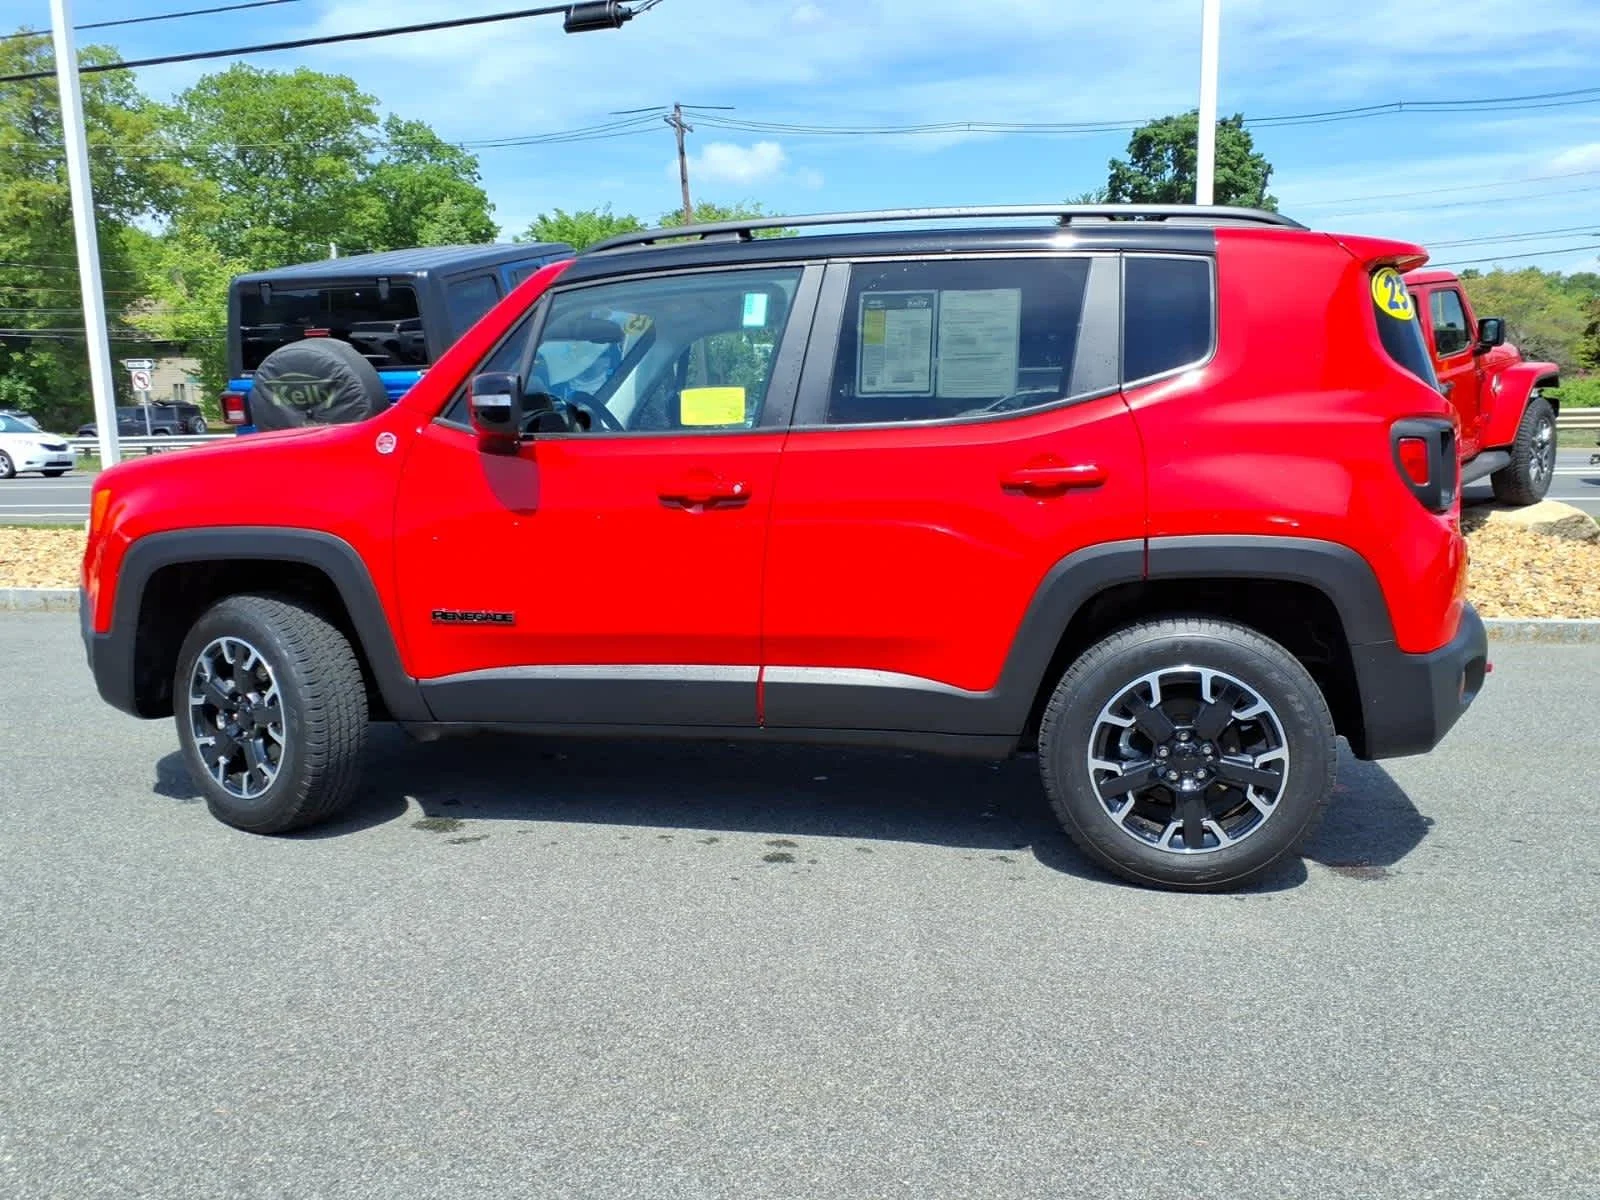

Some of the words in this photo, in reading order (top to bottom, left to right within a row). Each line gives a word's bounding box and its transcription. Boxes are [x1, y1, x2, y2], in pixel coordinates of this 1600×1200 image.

[1384, 274, 1409, 310] 23
[270, 384, 338, 409] Kelly
[431, 609, 515, 623] RENEGADE
